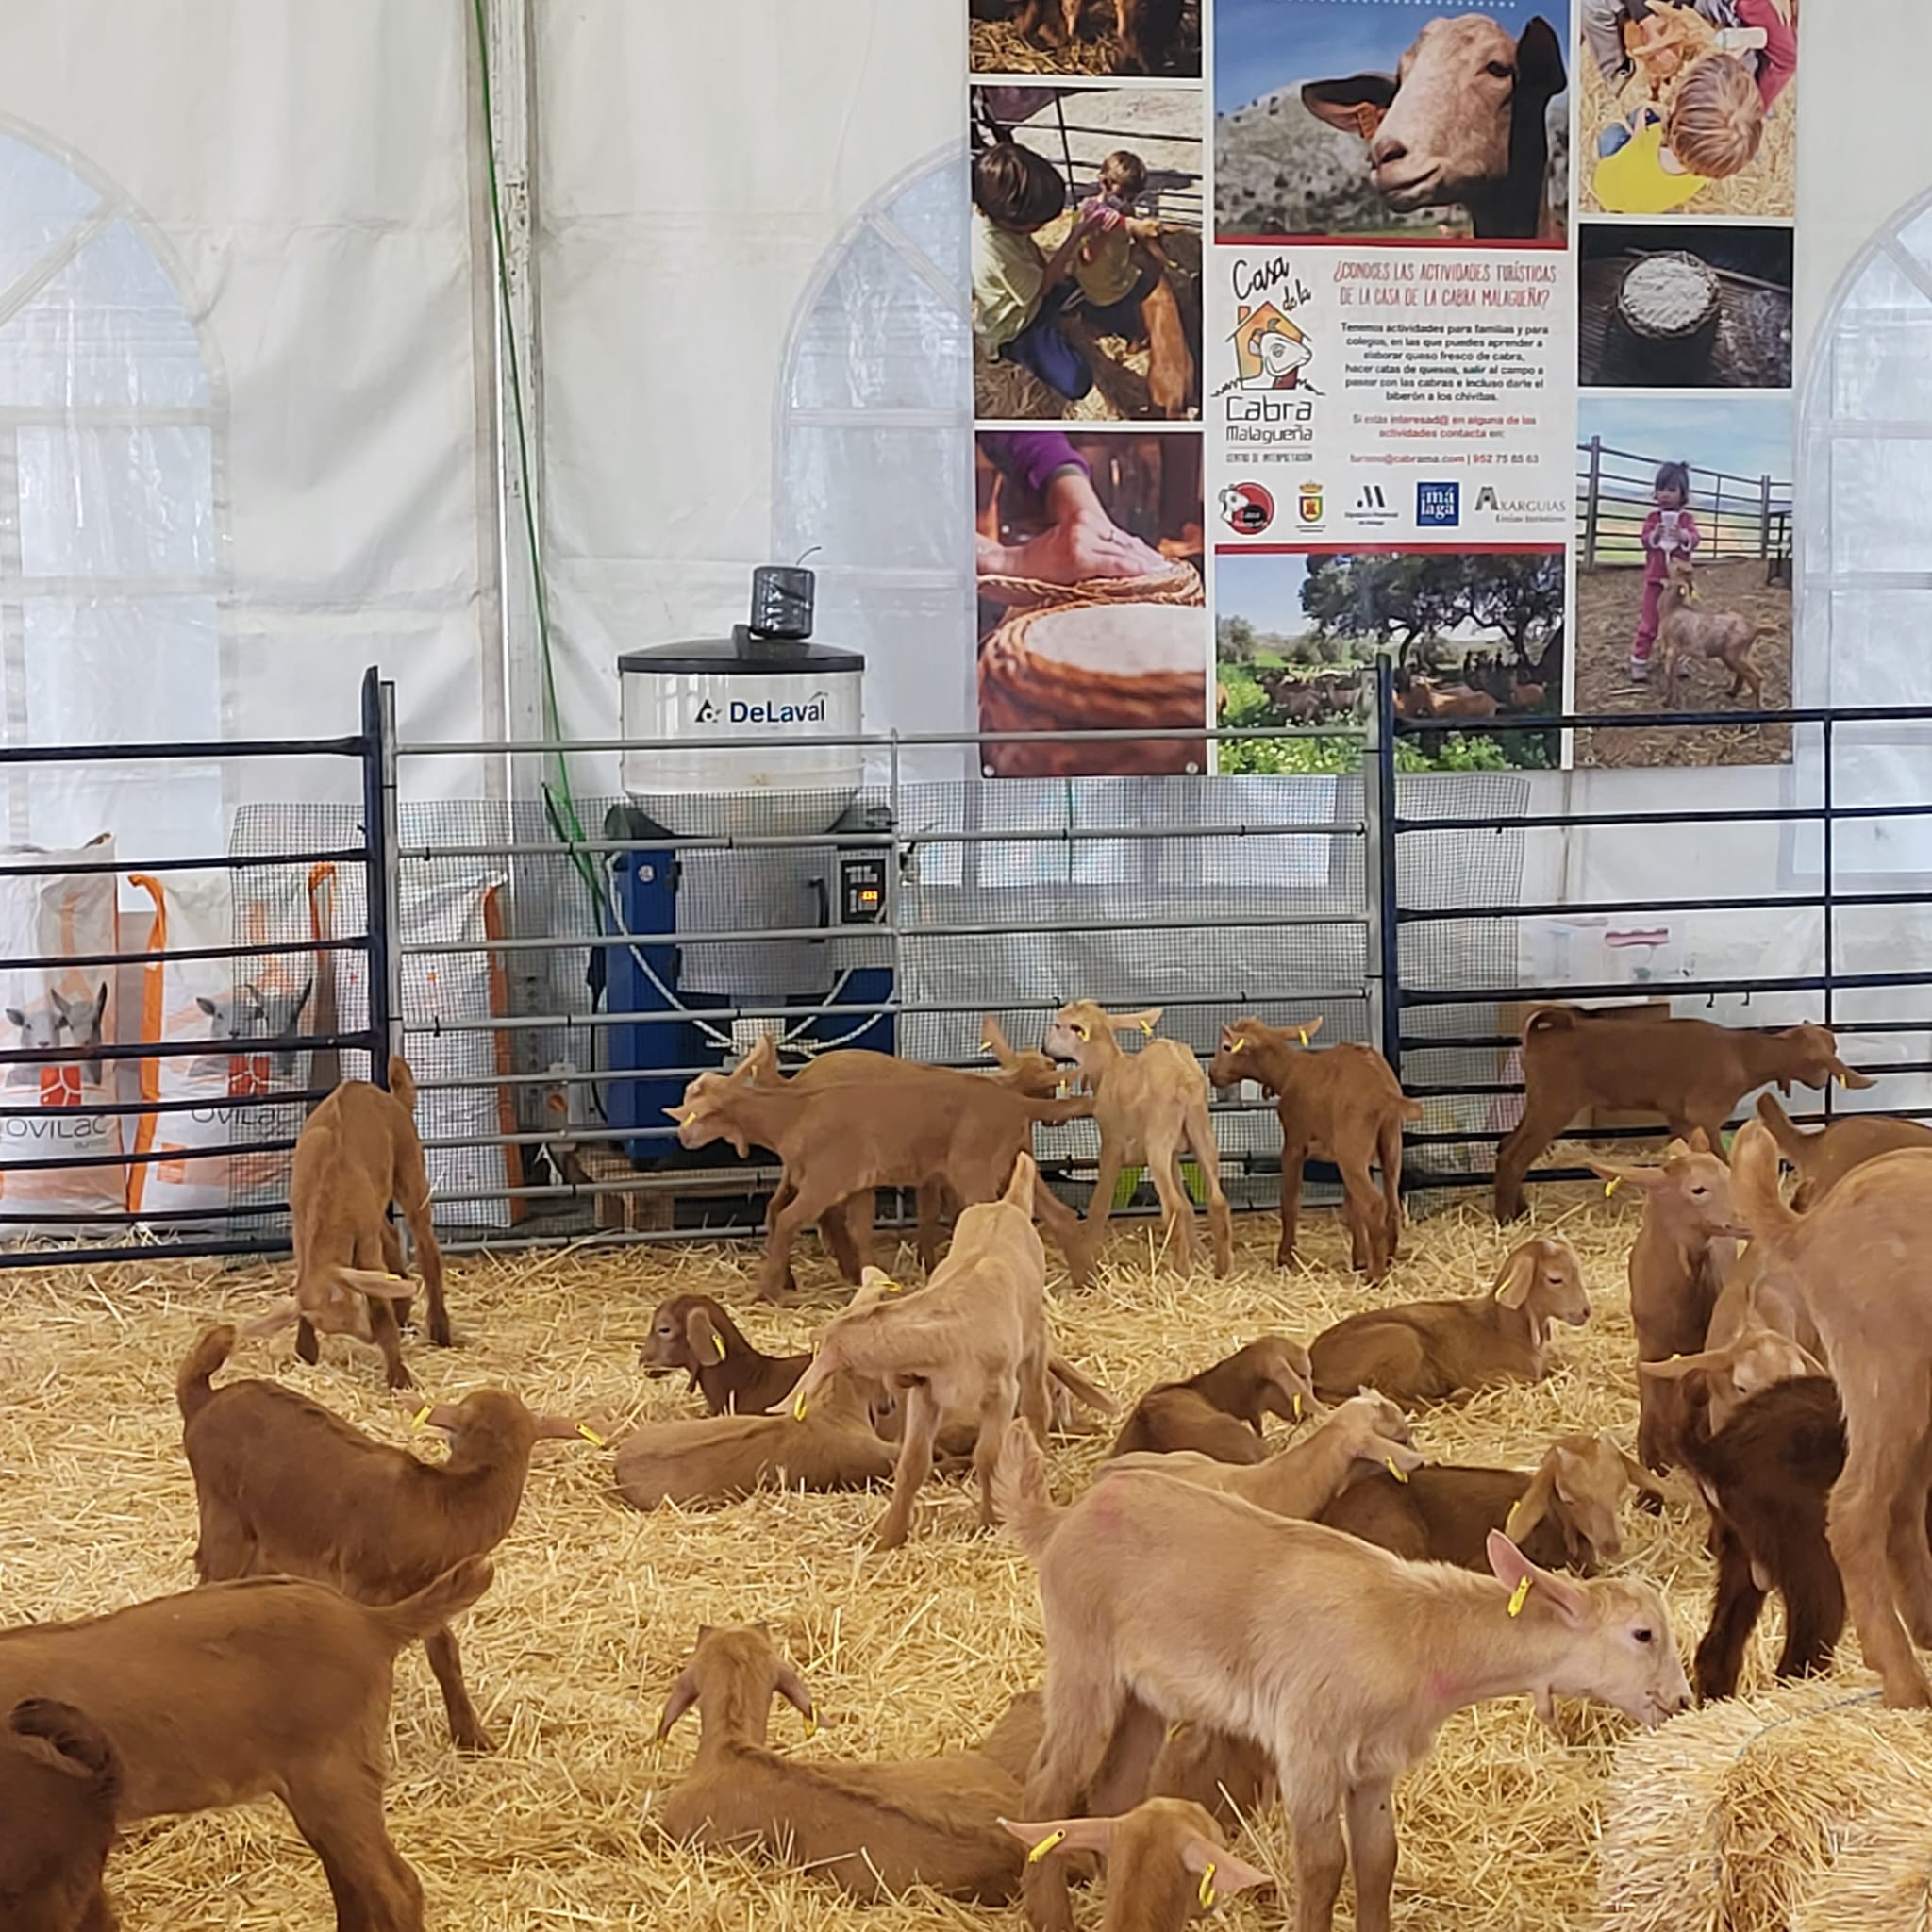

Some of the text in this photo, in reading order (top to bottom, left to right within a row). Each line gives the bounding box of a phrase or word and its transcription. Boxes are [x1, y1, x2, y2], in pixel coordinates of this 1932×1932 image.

[1233, 257, 1290, 300] Casa
[1394, 262, 1414, 281] LAS
[1420, 263, 1491, 282] ACTIVIDADES
[1496, 260, 1557, 283] TURÍSTICAS
[1283, 279, 1311, 311] de la
[1340, 287, 1550, 310] DE LA CASA DE LA CABRA MALAGUEÑA?
[1386, 324, 1444, 333] actividades
[1525, 326, 1549, 336] para
[1423, 339, 1442, 348] que
[1444, 338, 1485, 348] puedes
[1488, 339, 1534, 348] aprender
[1405, 352, 1438, 361] queso
[1440, 351, 1474, 360] fresco
[1476, 352, 1490, 360] de
[1404, 365, 1416, 374] de
[1418, 378, 1454, 387] cabras
[1227, 394, 1312, 422] Cabra
[1507, 416, 1519, 425] de
[1227, 424, 1313, 444] Malagueña
[1440, 429, 1486, 438] contacta
[730, 698, 824, 724] DeLaval
